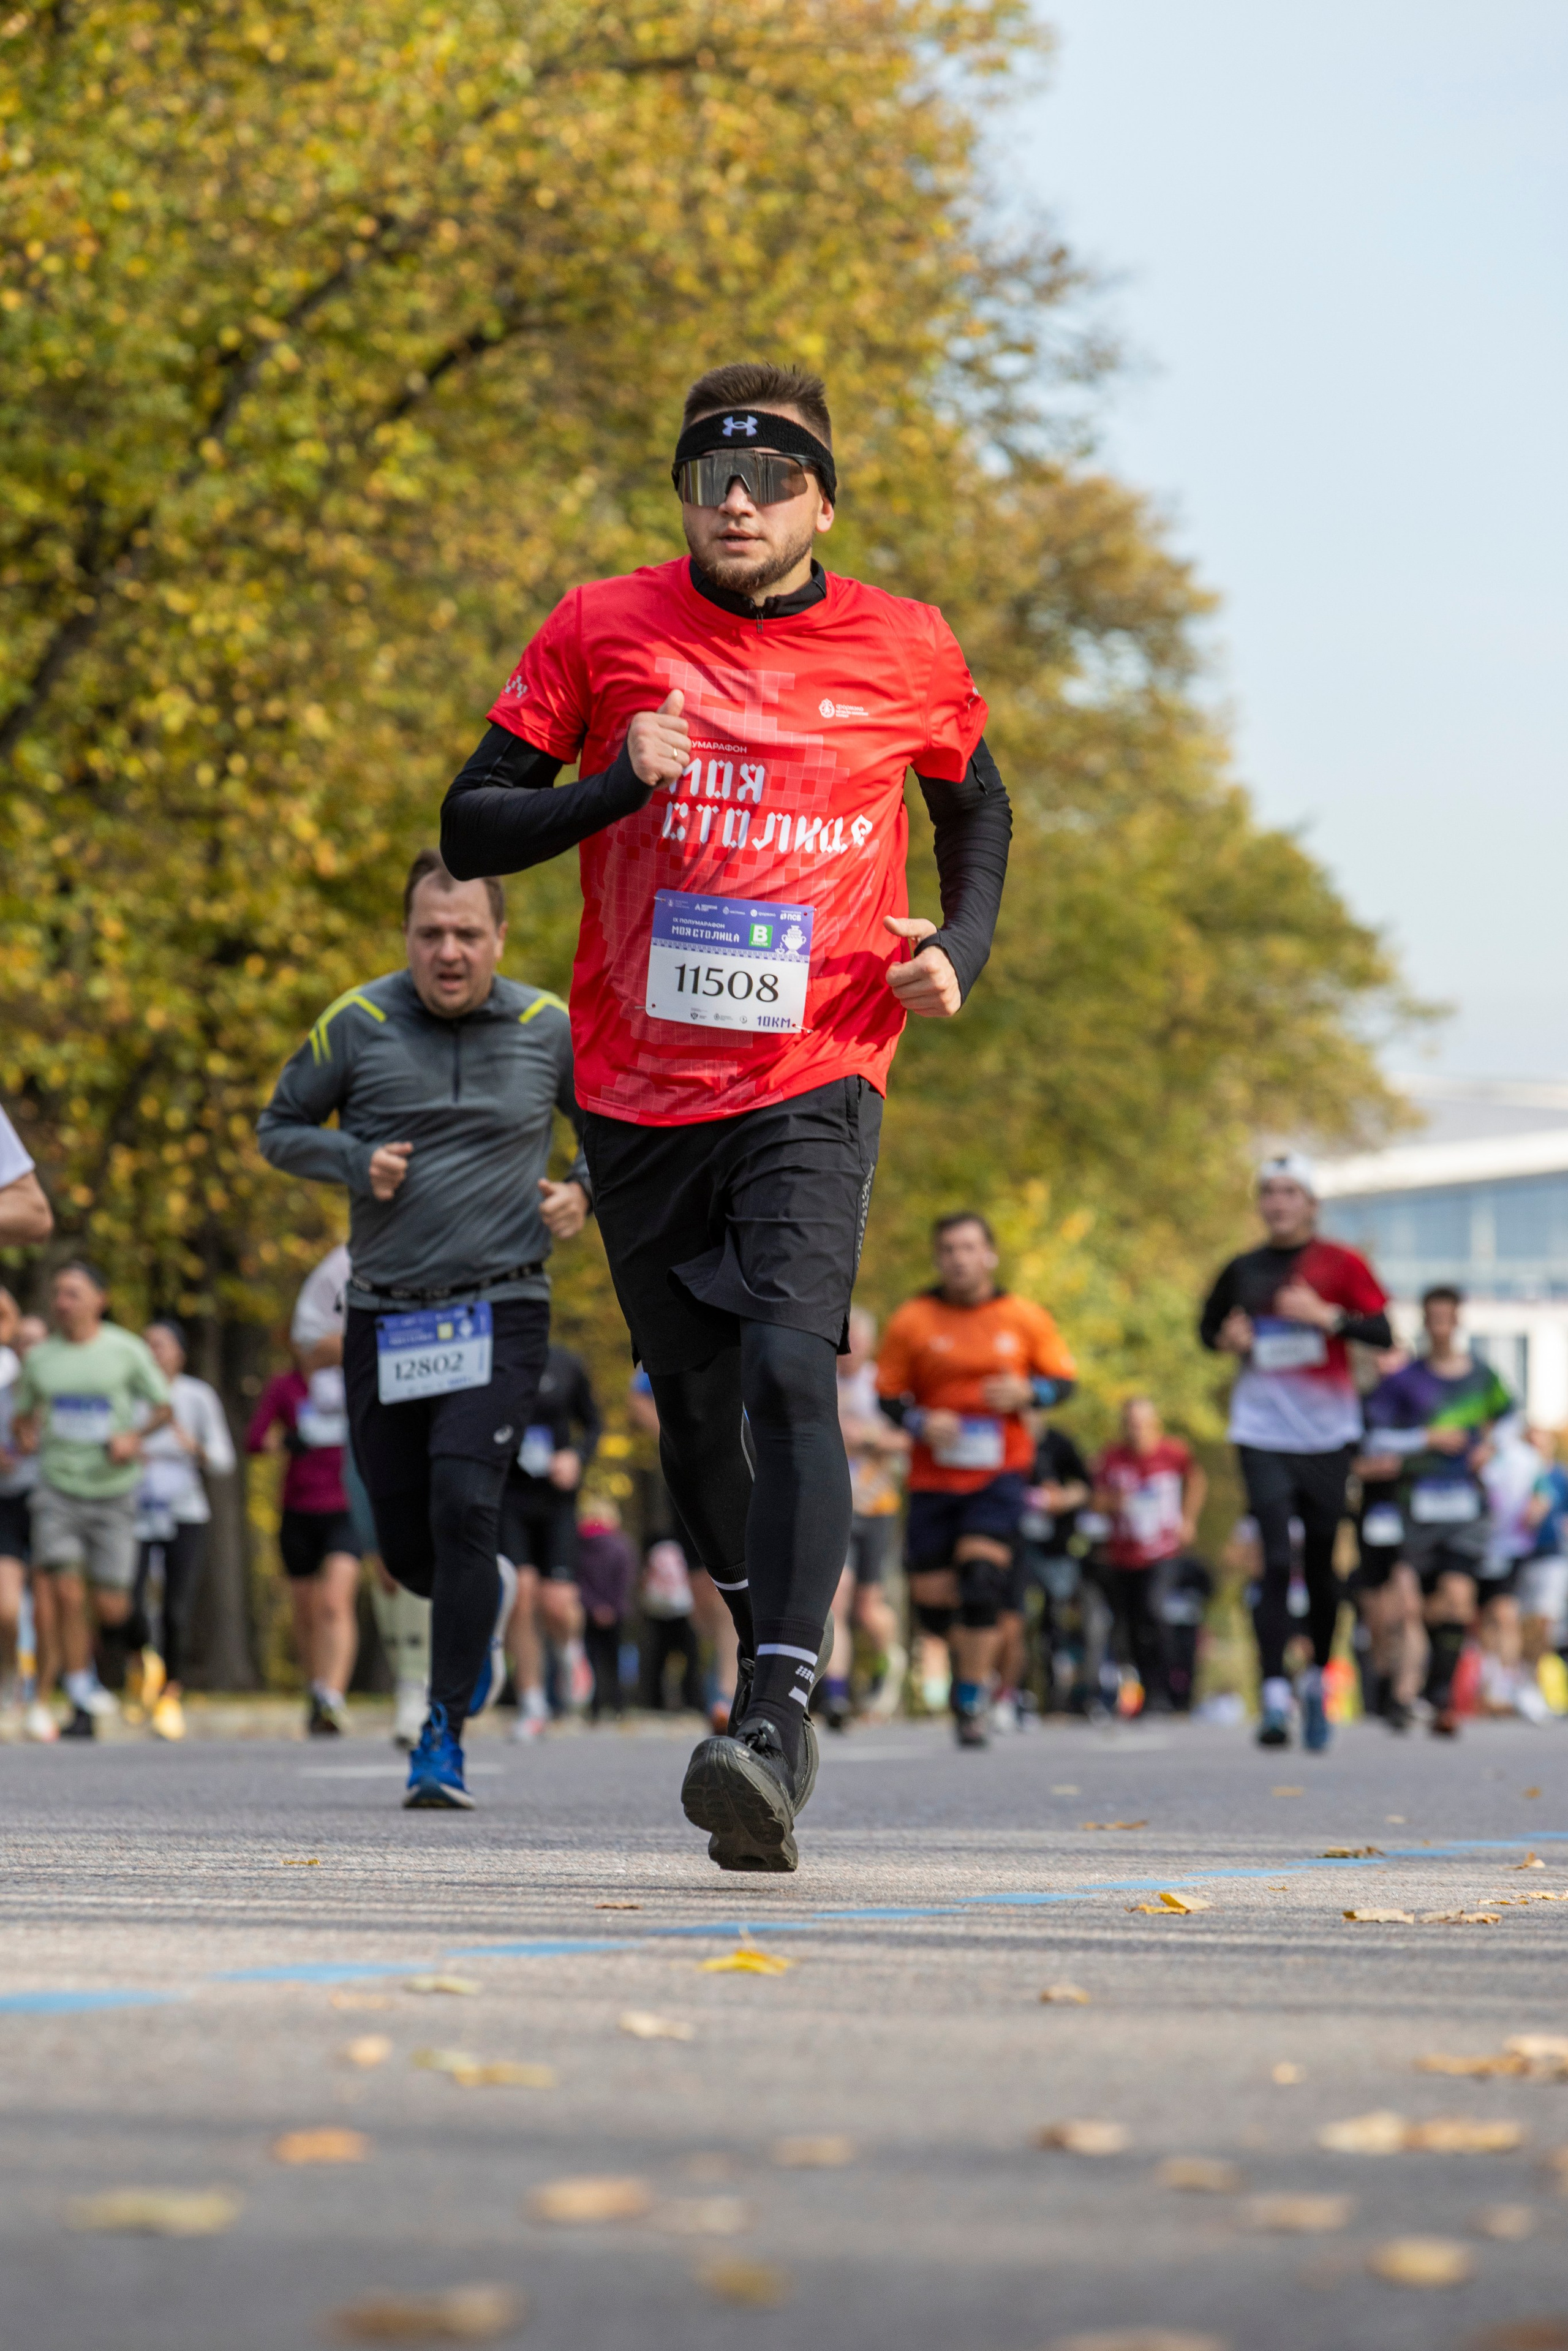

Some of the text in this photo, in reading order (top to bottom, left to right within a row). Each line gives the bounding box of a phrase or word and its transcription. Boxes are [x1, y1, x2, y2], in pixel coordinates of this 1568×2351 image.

[692, 740, 747, 754] УМАРАФОН
[679, 918, 725, 929] ПОЛУМАРАФОН
[671, 925, 740, 943] МОЯ СТОЛИЦА
[674, 963, 779, 1003] 11508
[396, 1351, 464, 1381] 12802
